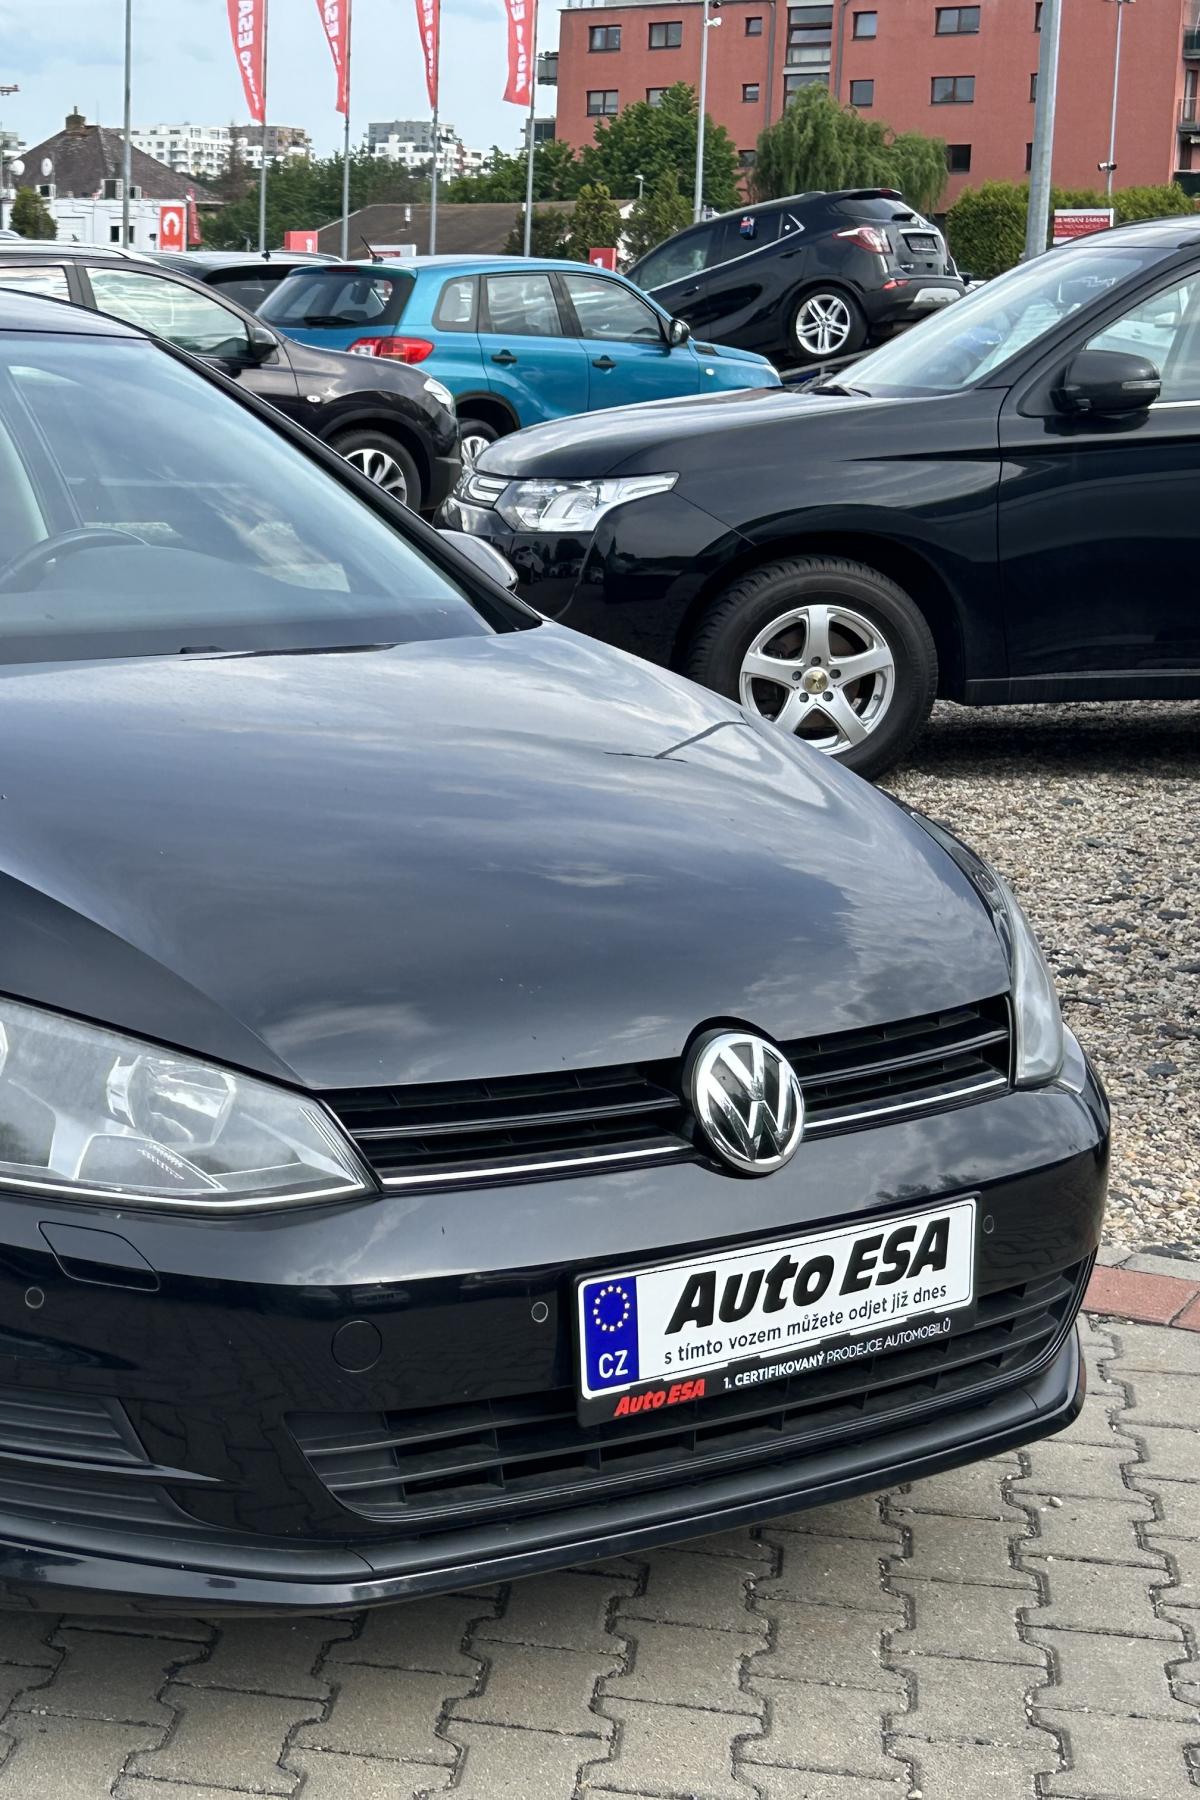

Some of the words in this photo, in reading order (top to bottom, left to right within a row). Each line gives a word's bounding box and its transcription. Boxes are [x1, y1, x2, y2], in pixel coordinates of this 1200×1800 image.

[664, 1254, 834, 1335] Auto
[838, 1216, 951, 1296] ESA
[664, 1352, 673, 1365] s
[678, 1340, 723, 1362] tímto
[729, 1327, 782, 1350] vozem
[786, 1310, 843, 1336] můžete
[848, 1297, 888, 1320] odjet
[891, 1291, 909, 1313] již
[913, 1284, 947, 1304] dnes
[723, 1377, 732, 1389] 1.
[734, 1350, 825, 1387] CERTIFIKOVANÝ
[826, 1338, 883, 1364] PRODEJCE
[883, 1317, 951, 1349] AUTOMOBILŮ
[598, 1349, 629, 1379] CZ
[613, 1390, 666, 1417] Auto
[667, 1378, 706, 1404] ESA
